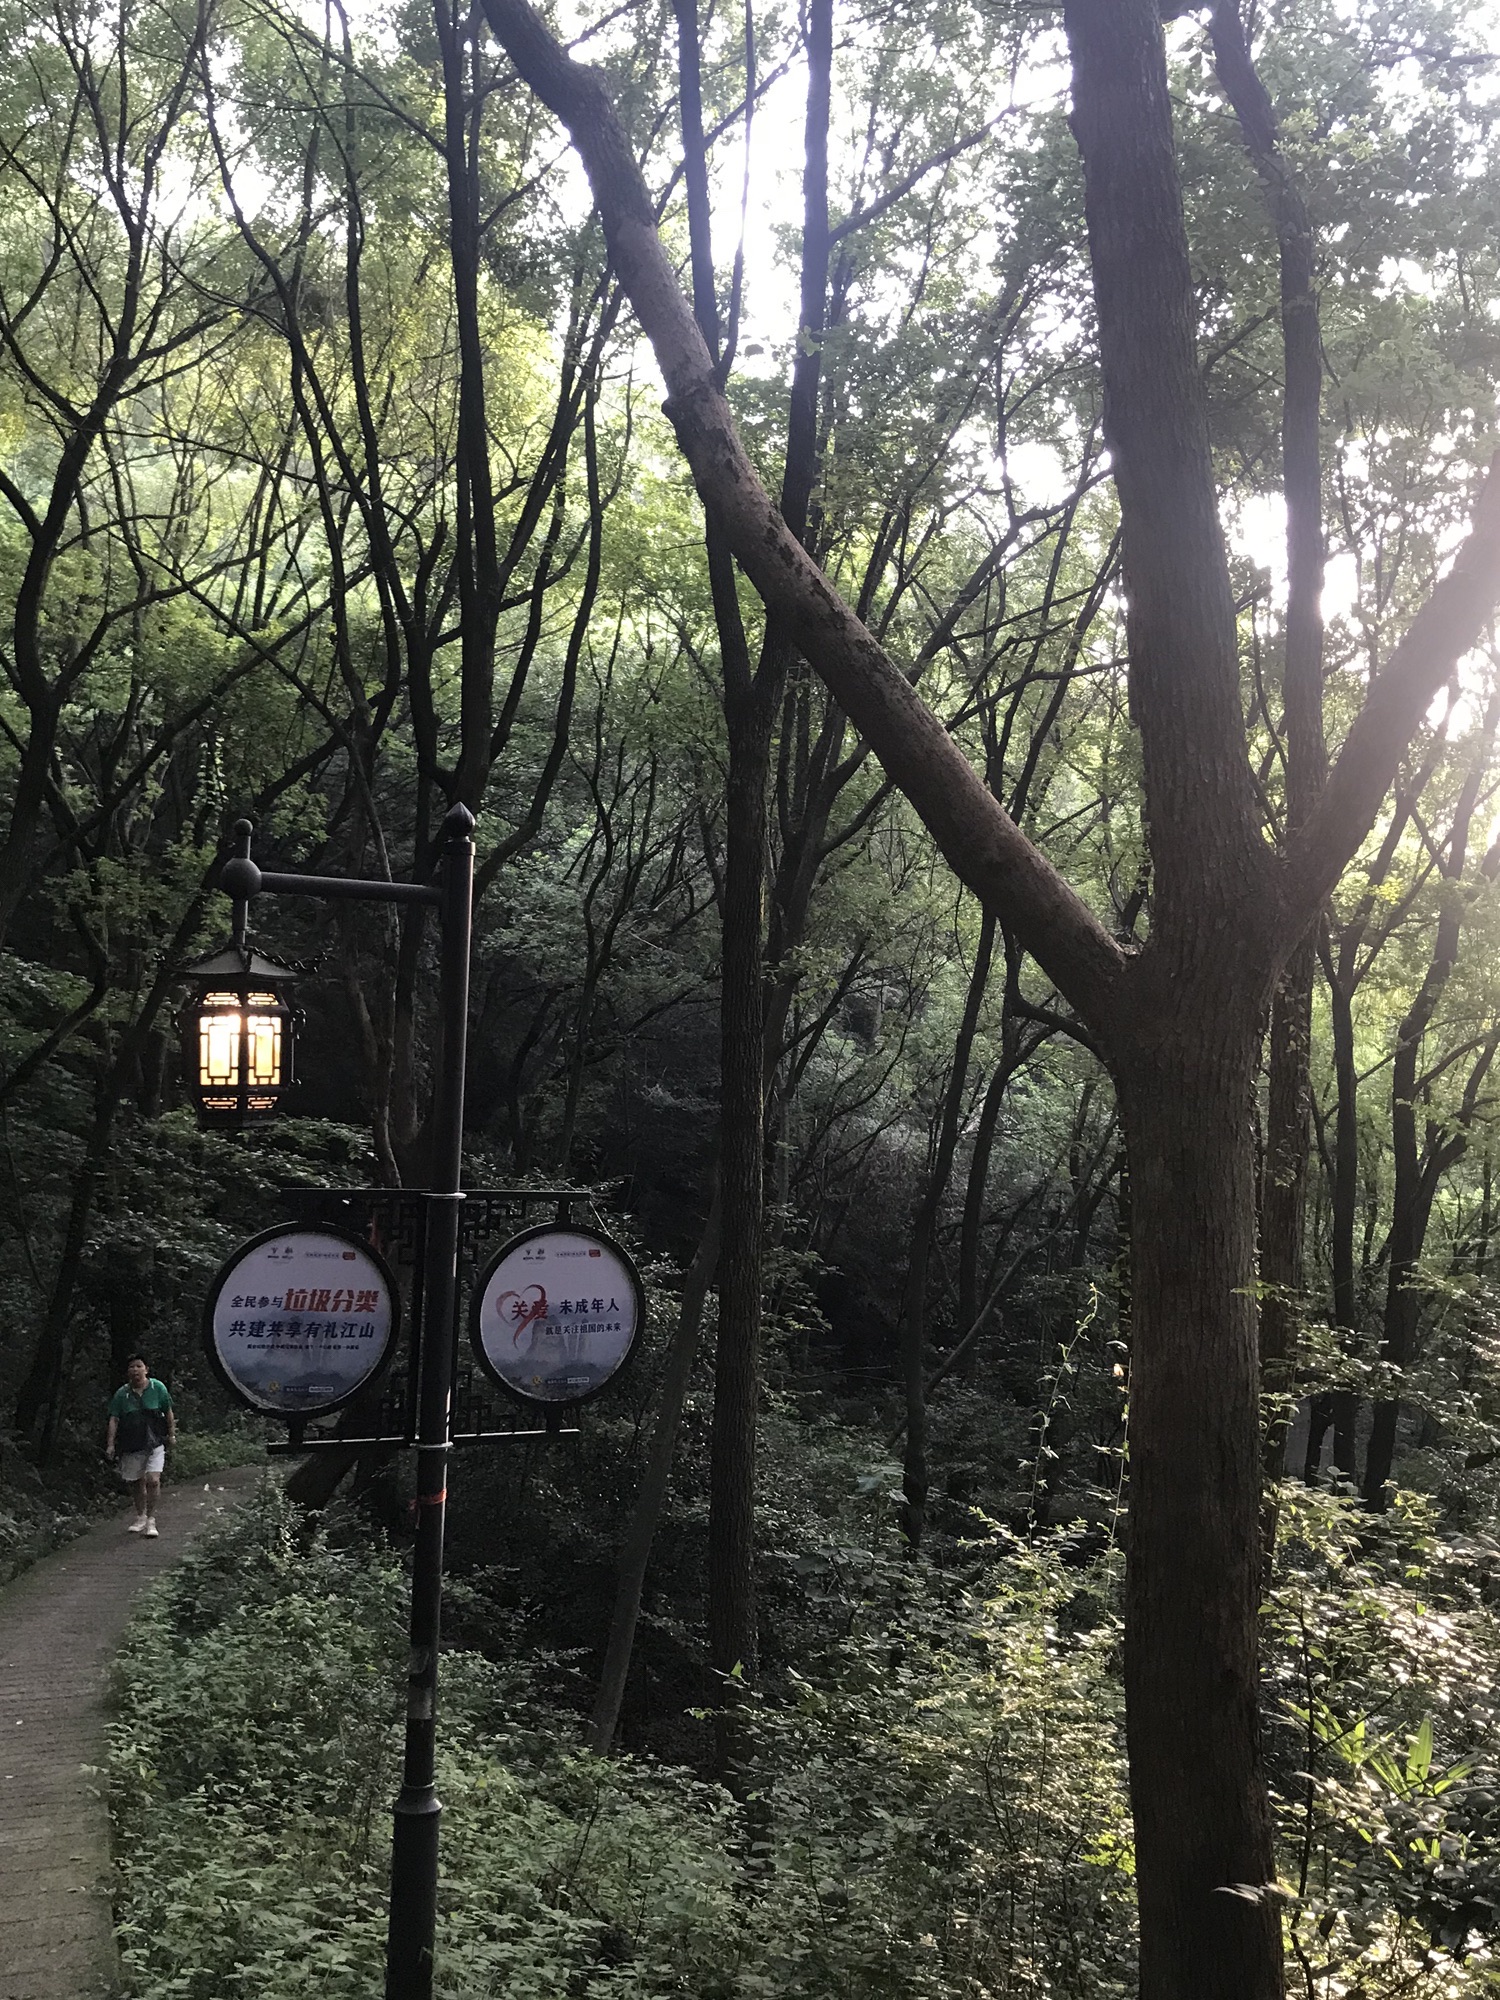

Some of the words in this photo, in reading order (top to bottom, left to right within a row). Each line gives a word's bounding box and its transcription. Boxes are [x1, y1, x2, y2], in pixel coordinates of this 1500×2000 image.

[228, 1320, 375, 1338] 共建共享有礼江山
[545, 1322, 622, 1335] 就是关注祖国的未来
